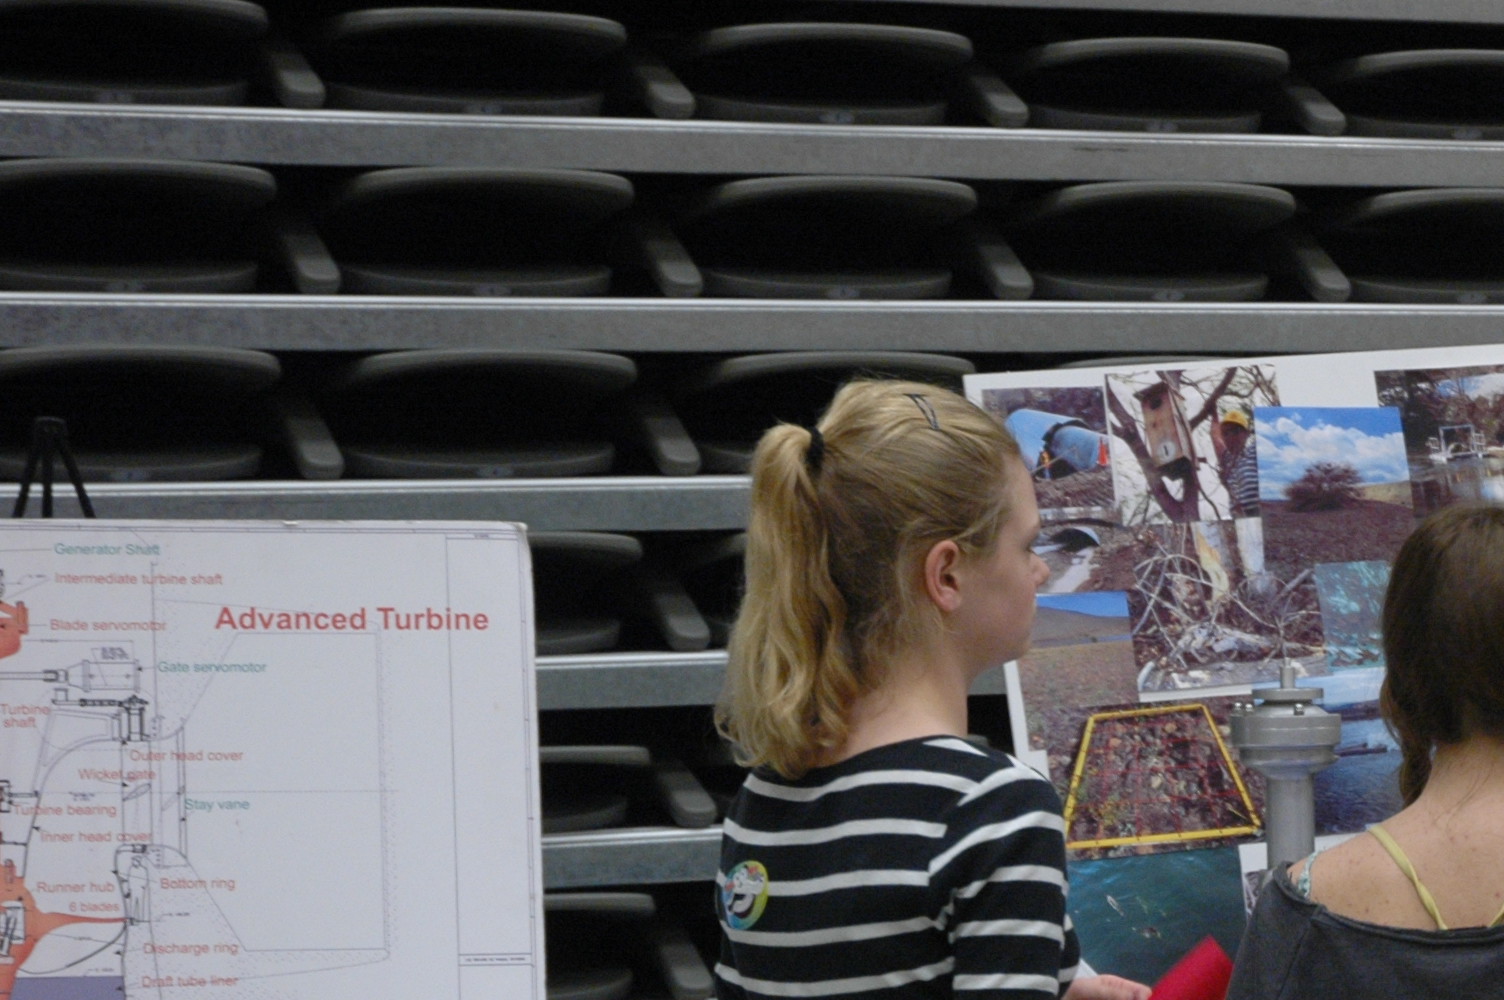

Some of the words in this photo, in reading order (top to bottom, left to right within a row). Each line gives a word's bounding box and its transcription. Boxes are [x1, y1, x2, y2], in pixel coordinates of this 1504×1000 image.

[54, 542, 121, 555] Generator
[126, 543, 161, 555] Shaft
[54, 573, 138, 585] Intermediate
[142, 573, 187, 585] turbine
[191, 573, 223, 585] shaft
[215, 606, 367, 630] Advanced
[376, 606, 489, 630] Turbine
[50, 619, 88, 631] Blade
[92, 620, 167, 632] servomotor
[158, 661, 190, 673] Gate
[194, 662, 267, 673] servomotor
[3, 717, 37, 729] shaft
[130, 750, 165, 761] Outer
[169, 749, 204, 761] head
[207, 752, 244, 761] cover
[78, 768, 123, 780] Wicket
[127, 770, 156, 783] gate
[14, 804, 63, 816] Turbine
[66, 804, 117, 817] bearing
[184, 798, 213, 811] Stay
[218, 800, 251, 810] vane
[41, 831, 74, 843] Inner
[78, 831, 113, 843] head
[116, 833, 153, 843] cover
[36, 881, 86, 893] Runner
[90, 881, 115, 893] hub
[160, 878, 207, 890] Bottom
[211, 878, 236, 891] ring
[80, 901, 120, 912] blades
[143, 942, 209, 956] Discharge
[212, 942, 239, 956] ring
[142, 975, 174, 987] Draft
[178, 976, 207, 987] tube
[210, 975, 239, 986] liner
